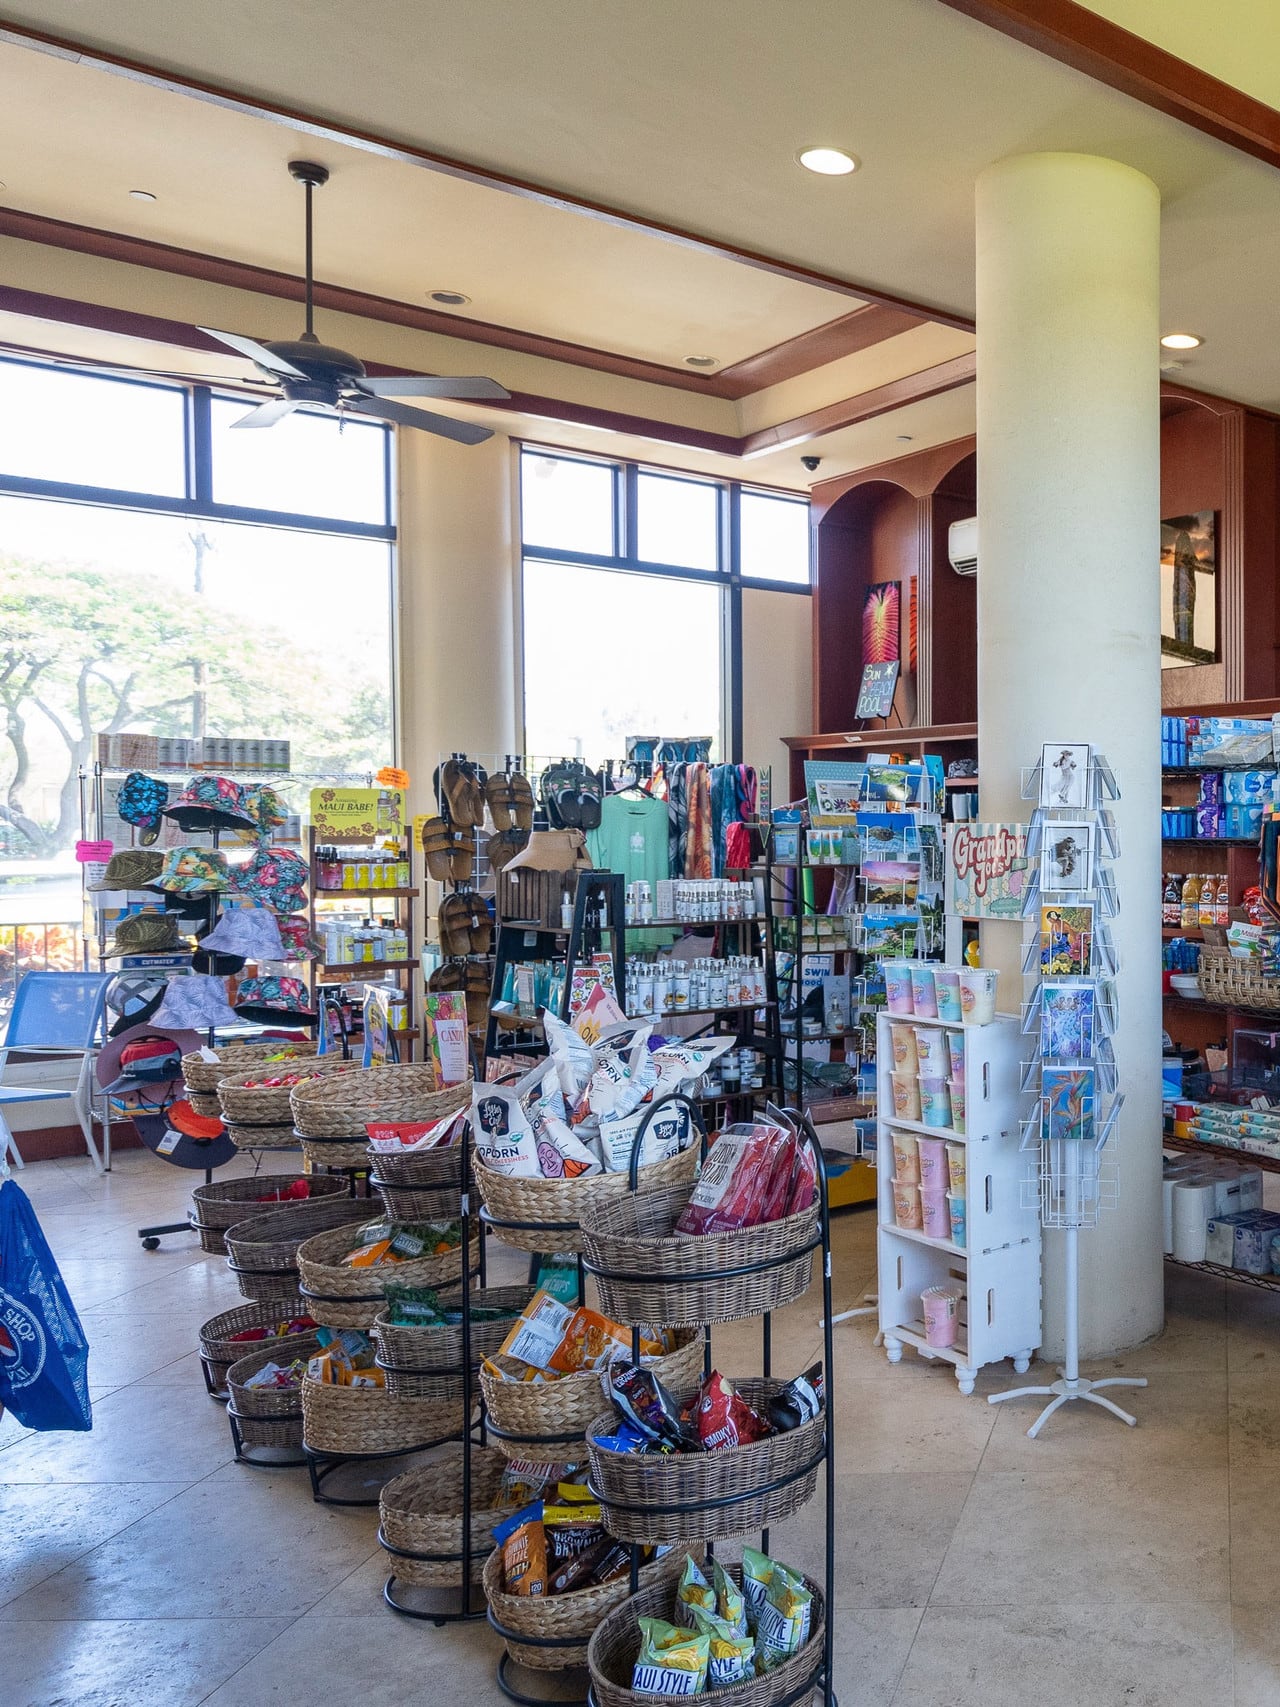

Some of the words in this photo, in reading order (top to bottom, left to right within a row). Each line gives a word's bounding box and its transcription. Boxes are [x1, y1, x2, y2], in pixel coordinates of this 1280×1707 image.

[858, 696, 882, 713] POOL
[319, 803, 346, 811] MAUI
[347, 803, 374, 812] BABE!
[4, 1308, 36, 1341] SHOP
[705, 1425, 732, 1449] SMOKY
[530, 1583, 542, 1595] 120
[772, 1615, 788, 1641] STYLE
[657, 1669, 692, 1694] STYLE
